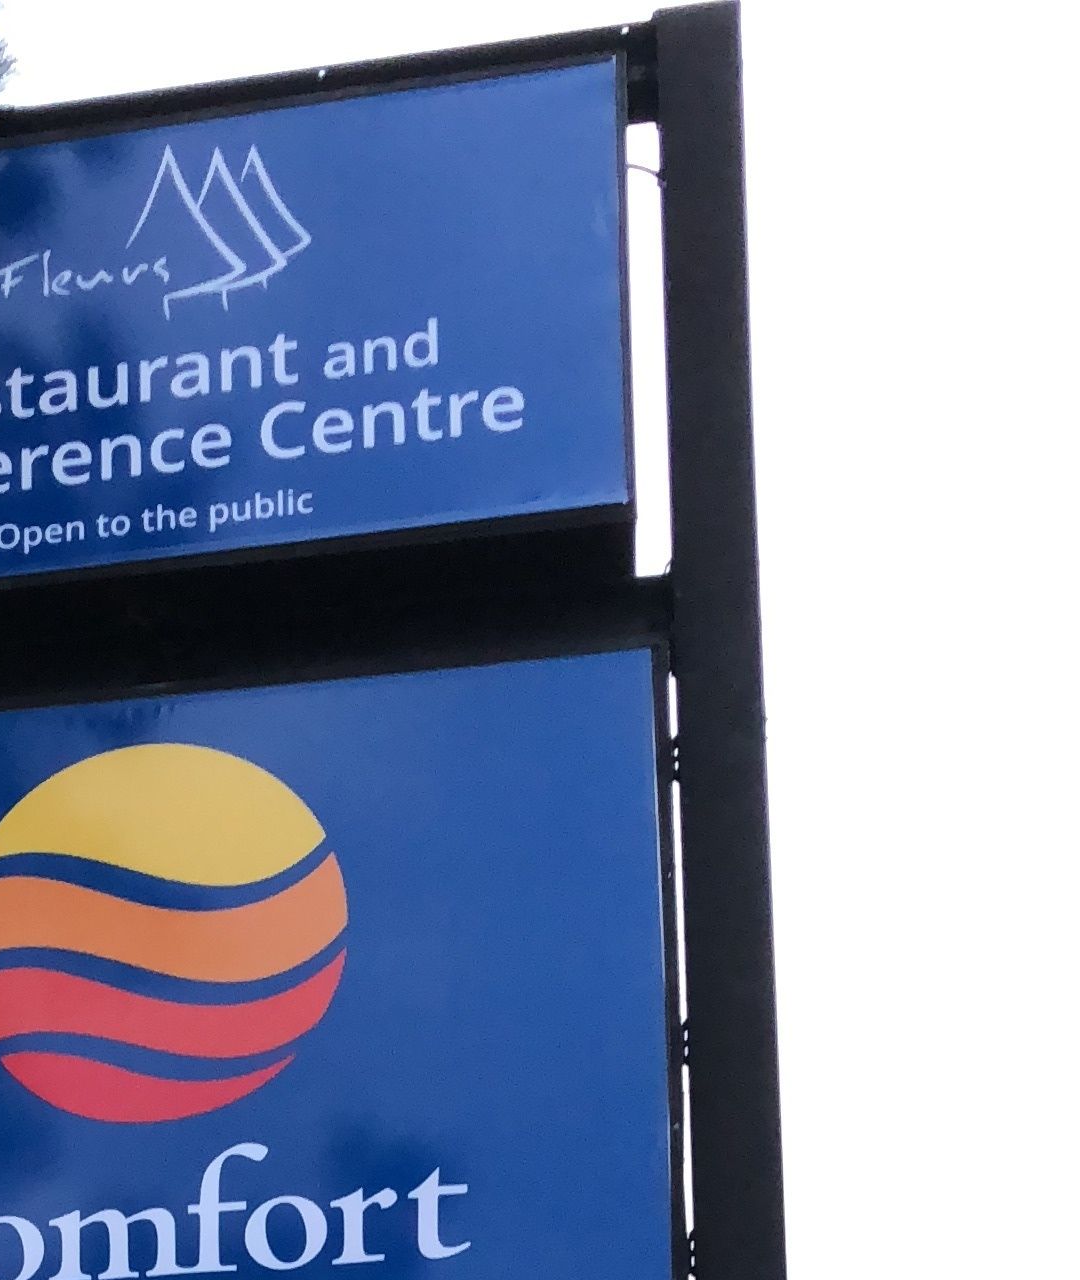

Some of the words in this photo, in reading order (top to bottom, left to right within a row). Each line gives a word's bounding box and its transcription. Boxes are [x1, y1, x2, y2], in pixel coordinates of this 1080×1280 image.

[322, 317, 439, 378] and
[259, 384, 526, 460] Centre
[95, 508, 132, 538] to
[141, 503, 199, 532] the
[208, 488, 315, 532] public
